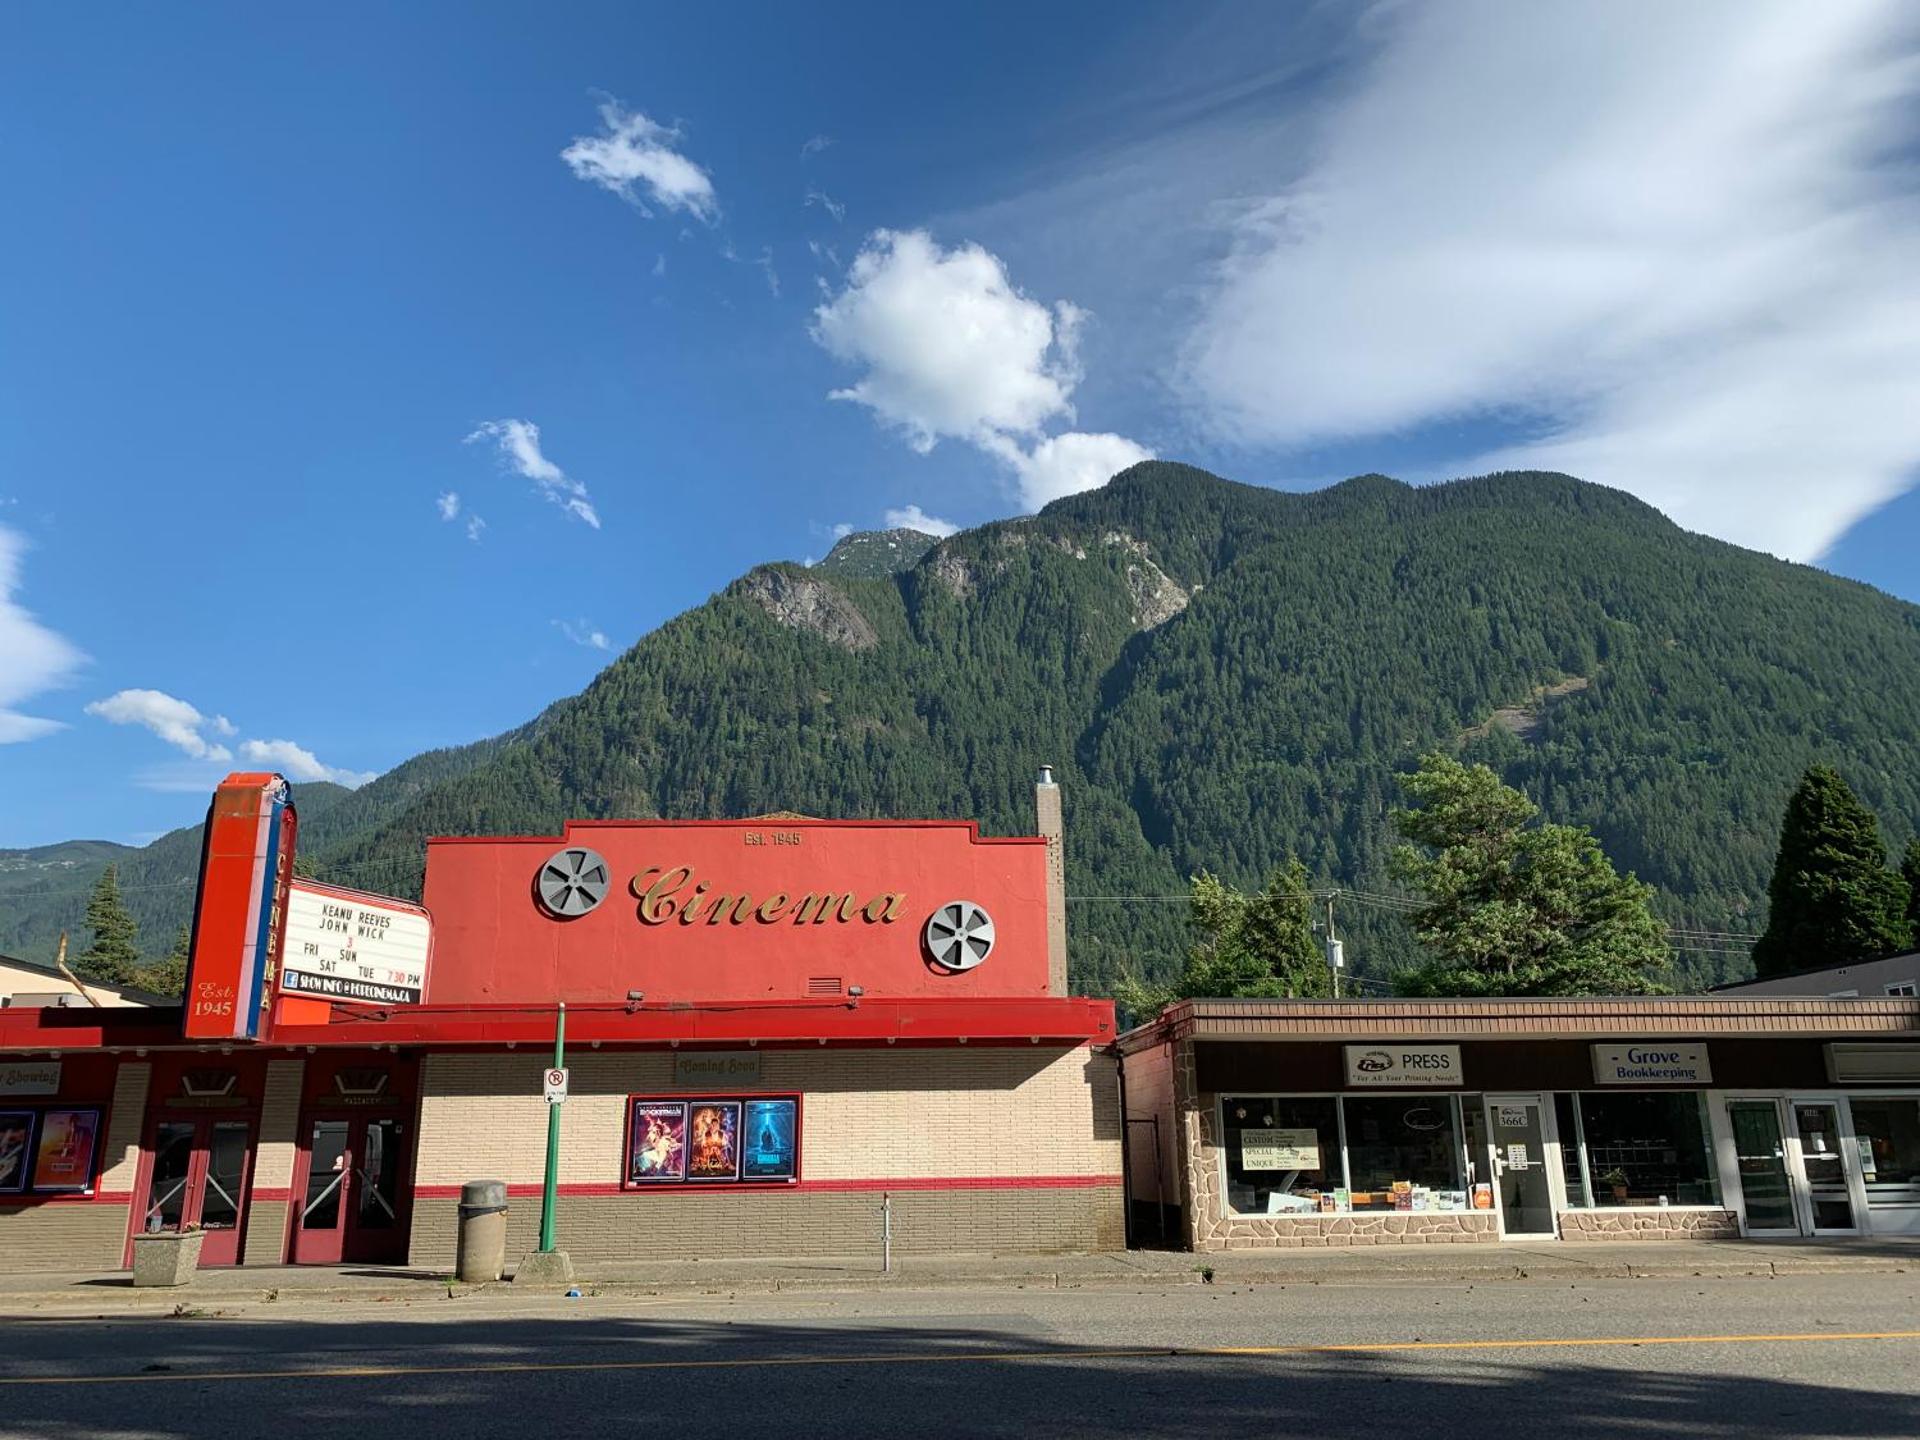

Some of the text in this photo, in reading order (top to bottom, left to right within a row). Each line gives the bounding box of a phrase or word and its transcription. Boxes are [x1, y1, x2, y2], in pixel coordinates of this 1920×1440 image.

[744, 832, 801, 845] Est. 1945
[628, 864, 907, 925] Cinema
[322, 904, 391, 928] KEANU REEVES
[260, 853, 287, 1010] CINEMA
[319, 919, 385, 940] JOHN WICK
[347, 937, 353, 948] 3
[304, 942, 357, 962] FRI SUN
[319, 959, 337, 972] SAT
[358, 966, 374, 978] TUE
[407, 974, 420, 986] PM
[198, 982, 235, 998] Est.
[194, 1001, 232, 1016] 1945
[1402, 1054, 1450, 1069] PRESS
[1628, 1047, 1680, 1065] Grove
[1617, 1067, 1696, 1080] Bookkeeping
[1243, 1136, 1273, 1144] CUSTOM
